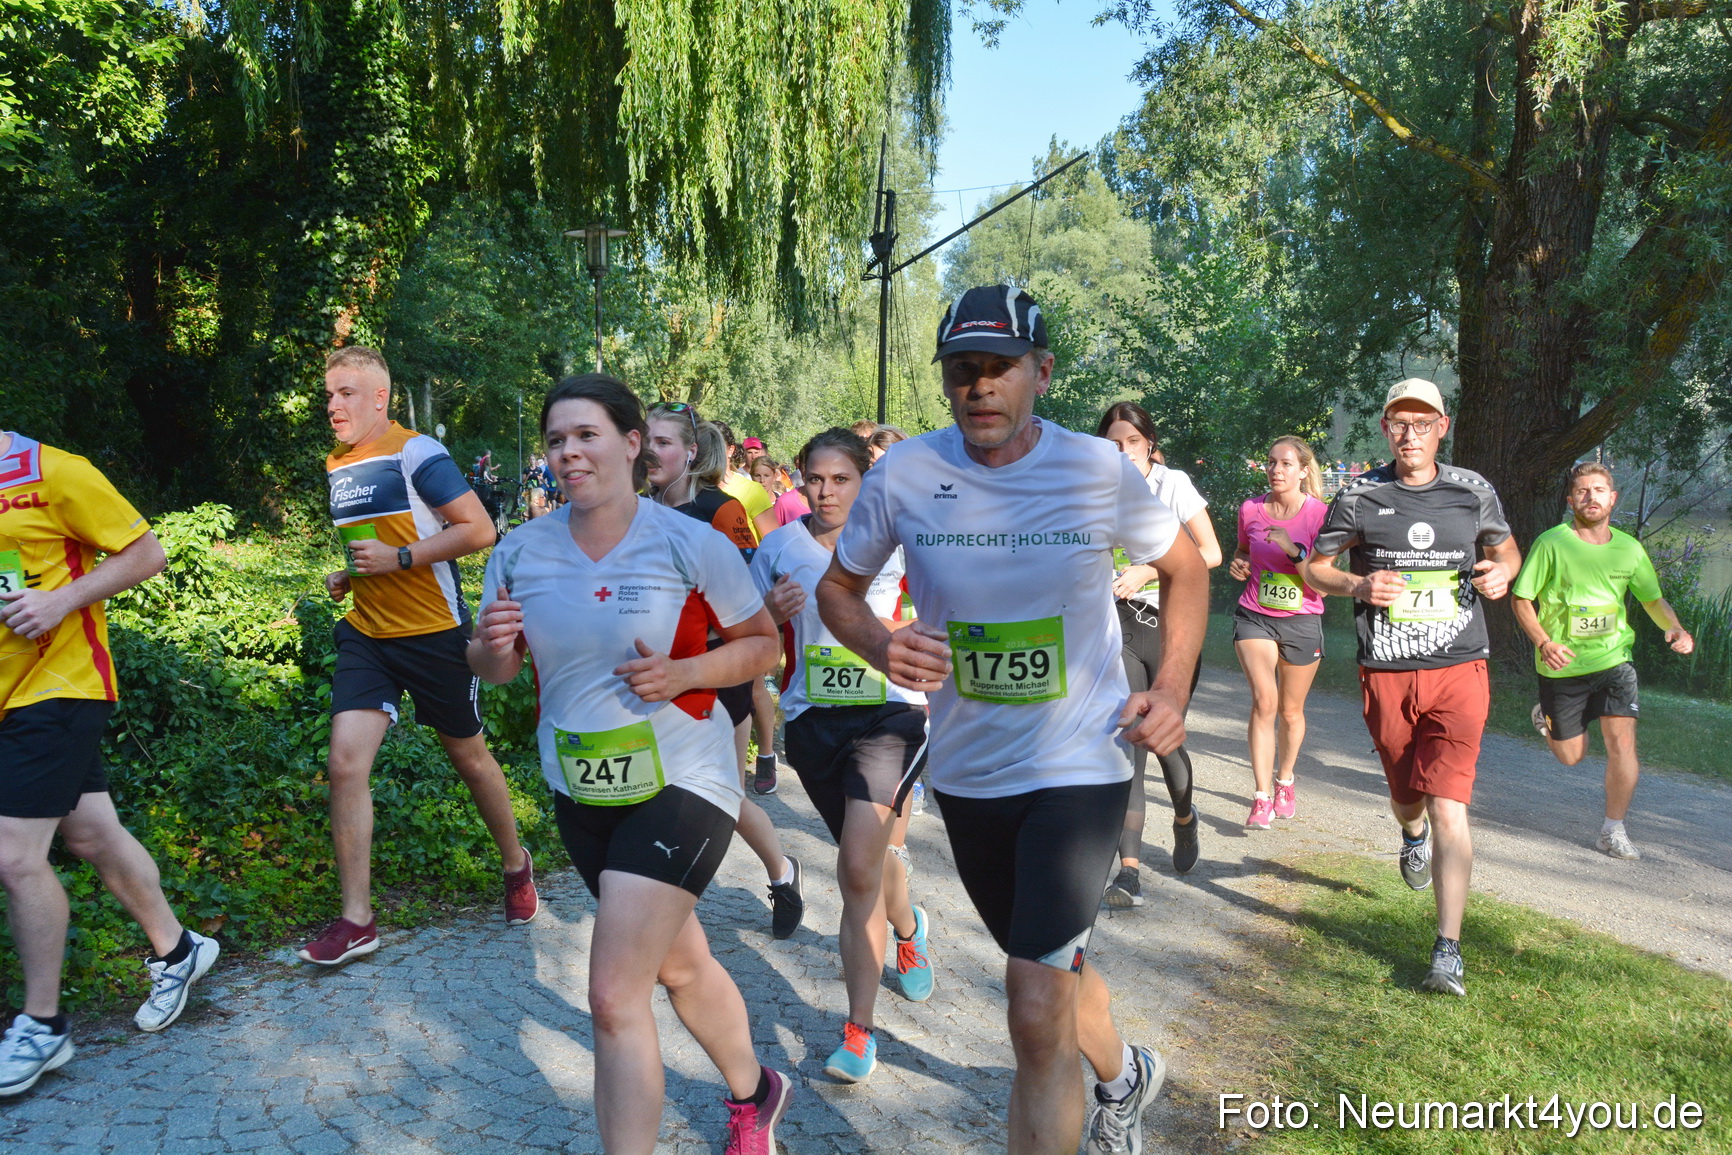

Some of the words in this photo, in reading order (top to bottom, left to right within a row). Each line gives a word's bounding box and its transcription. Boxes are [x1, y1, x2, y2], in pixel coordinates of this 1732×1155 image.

[334, 484, 377, 502] Fischer
[338, 497, 373, 508] AUTOMOBILE
[916, 533, 1008, 547] RUPPRECHT
[1018, 532, 1091, 545] HOLZBAU
[1394, 559, 1448, 567] SCHOTTERWERKE
[1262, 583, 1297, 600] 1436
[1410, 589, 1434, 608] 71
[1579, 616, 1607, 630] 341
[965, 649, 1050, 681] 1759
[822, 666, 867, 689] 267
[970, 680, 1014, 690] Rupprecht
[1015, 680, 1050, 690] Michael
[1028, 688, 1047, 696] GmbH
[575, 755, 633, 785] 247
[572, 783, 612, 793] Bauereisen
[612, 781, 654, 793] Katharina
